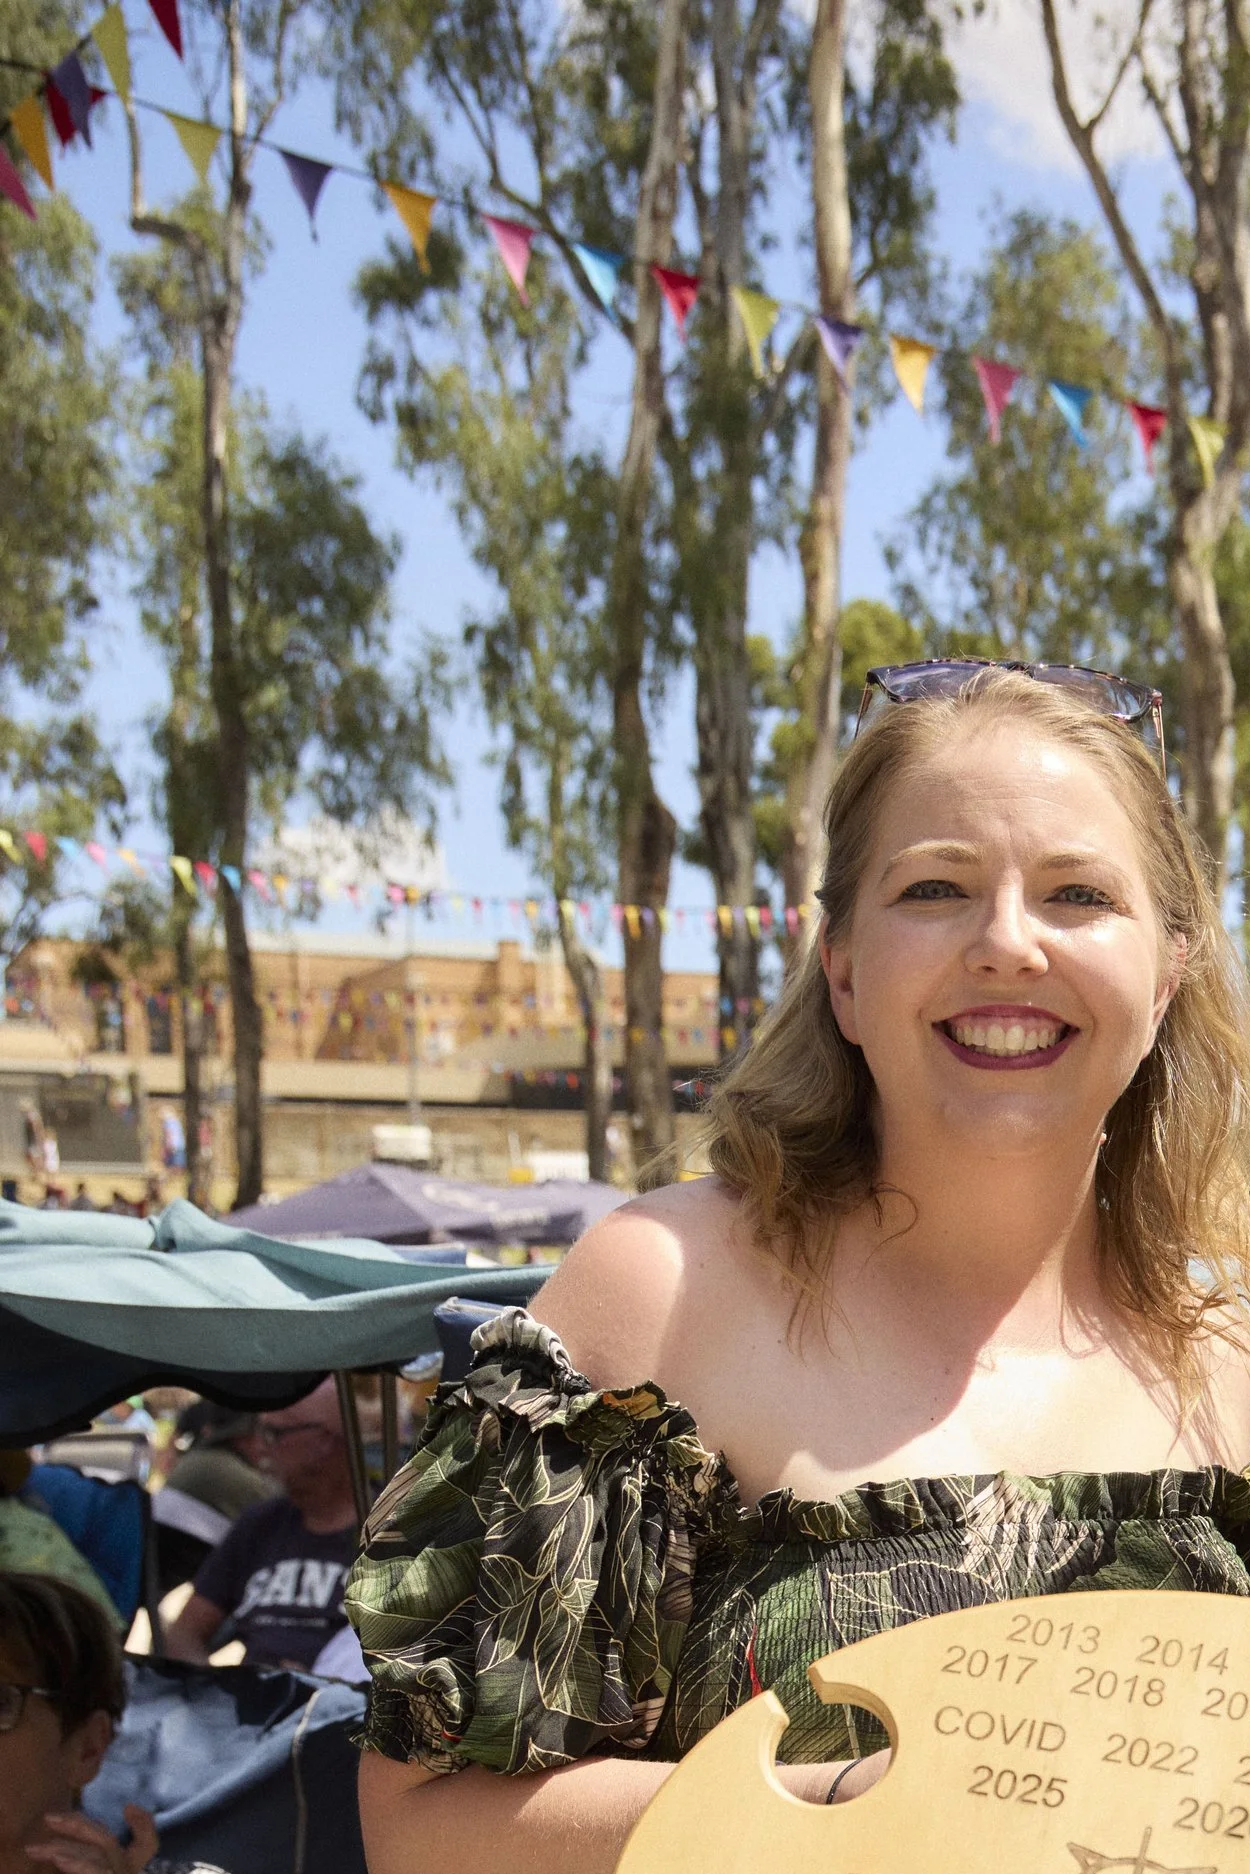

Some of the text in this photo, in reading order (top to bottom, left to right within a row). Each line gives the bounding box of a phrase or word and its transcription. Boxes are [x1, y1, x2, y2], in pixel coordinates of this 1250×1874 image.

[1005, 1614, 1101, 1655] 2013
[1135, 1635, 1230, 1676] 2014
[941, 1645, 1038, 1685] 2017
[1070, 1666, 1166, 1708] 2018
[934, 1705, 1067, 1754] COVID
[1102, 1732, 1199, 1777] 2022
[967, 1764, 1068, 1809] 2025
